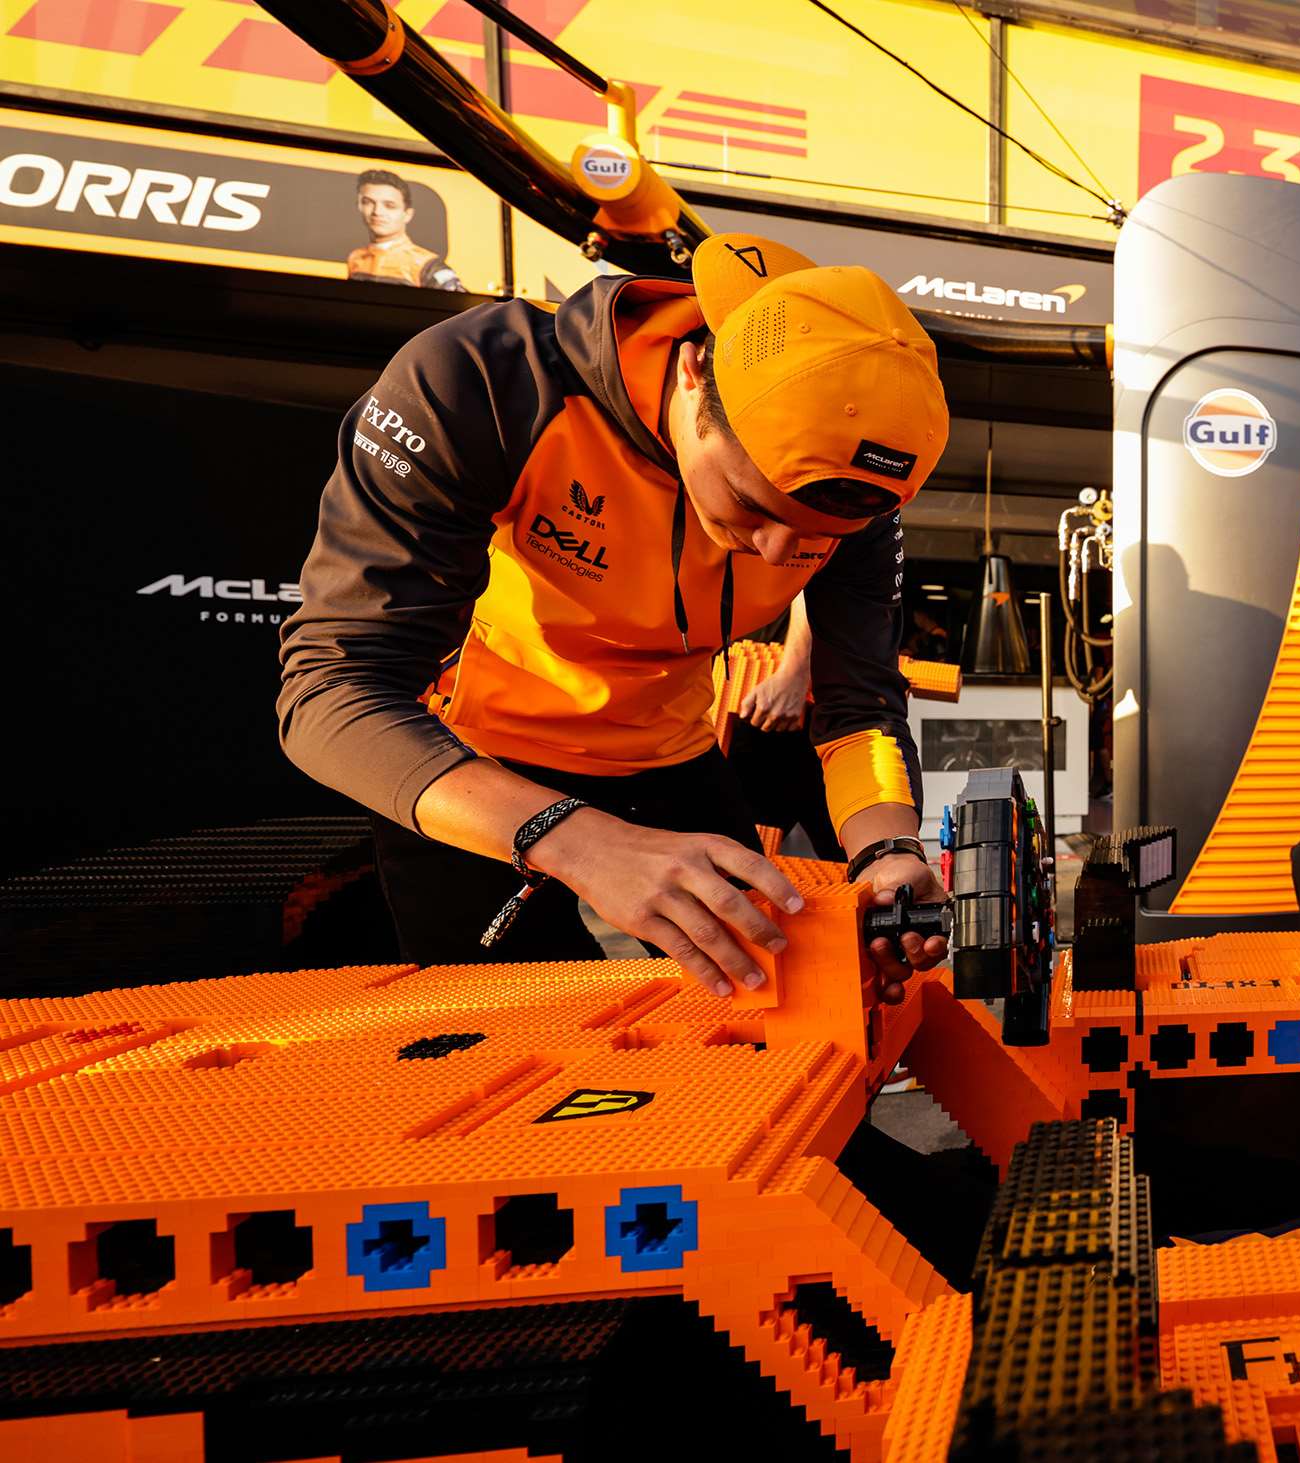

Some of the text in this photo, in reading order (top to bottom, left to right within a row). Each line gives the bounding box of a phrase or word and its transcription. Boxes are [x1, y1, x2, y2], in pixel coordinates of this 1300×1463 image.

[584, 159, 627, 173] Gulf
[0, 153, 271, 232] ORRIS
[897, 275, 1066, 314] McLaren
[362, 395, 426, 454] FxPro
[1189, 420, 1270, 446] Gulf
[863, 451, 905, 468] McLaren
[526, 533, 604, 583] Technologies
[529, 513, 609, 570] DELL
